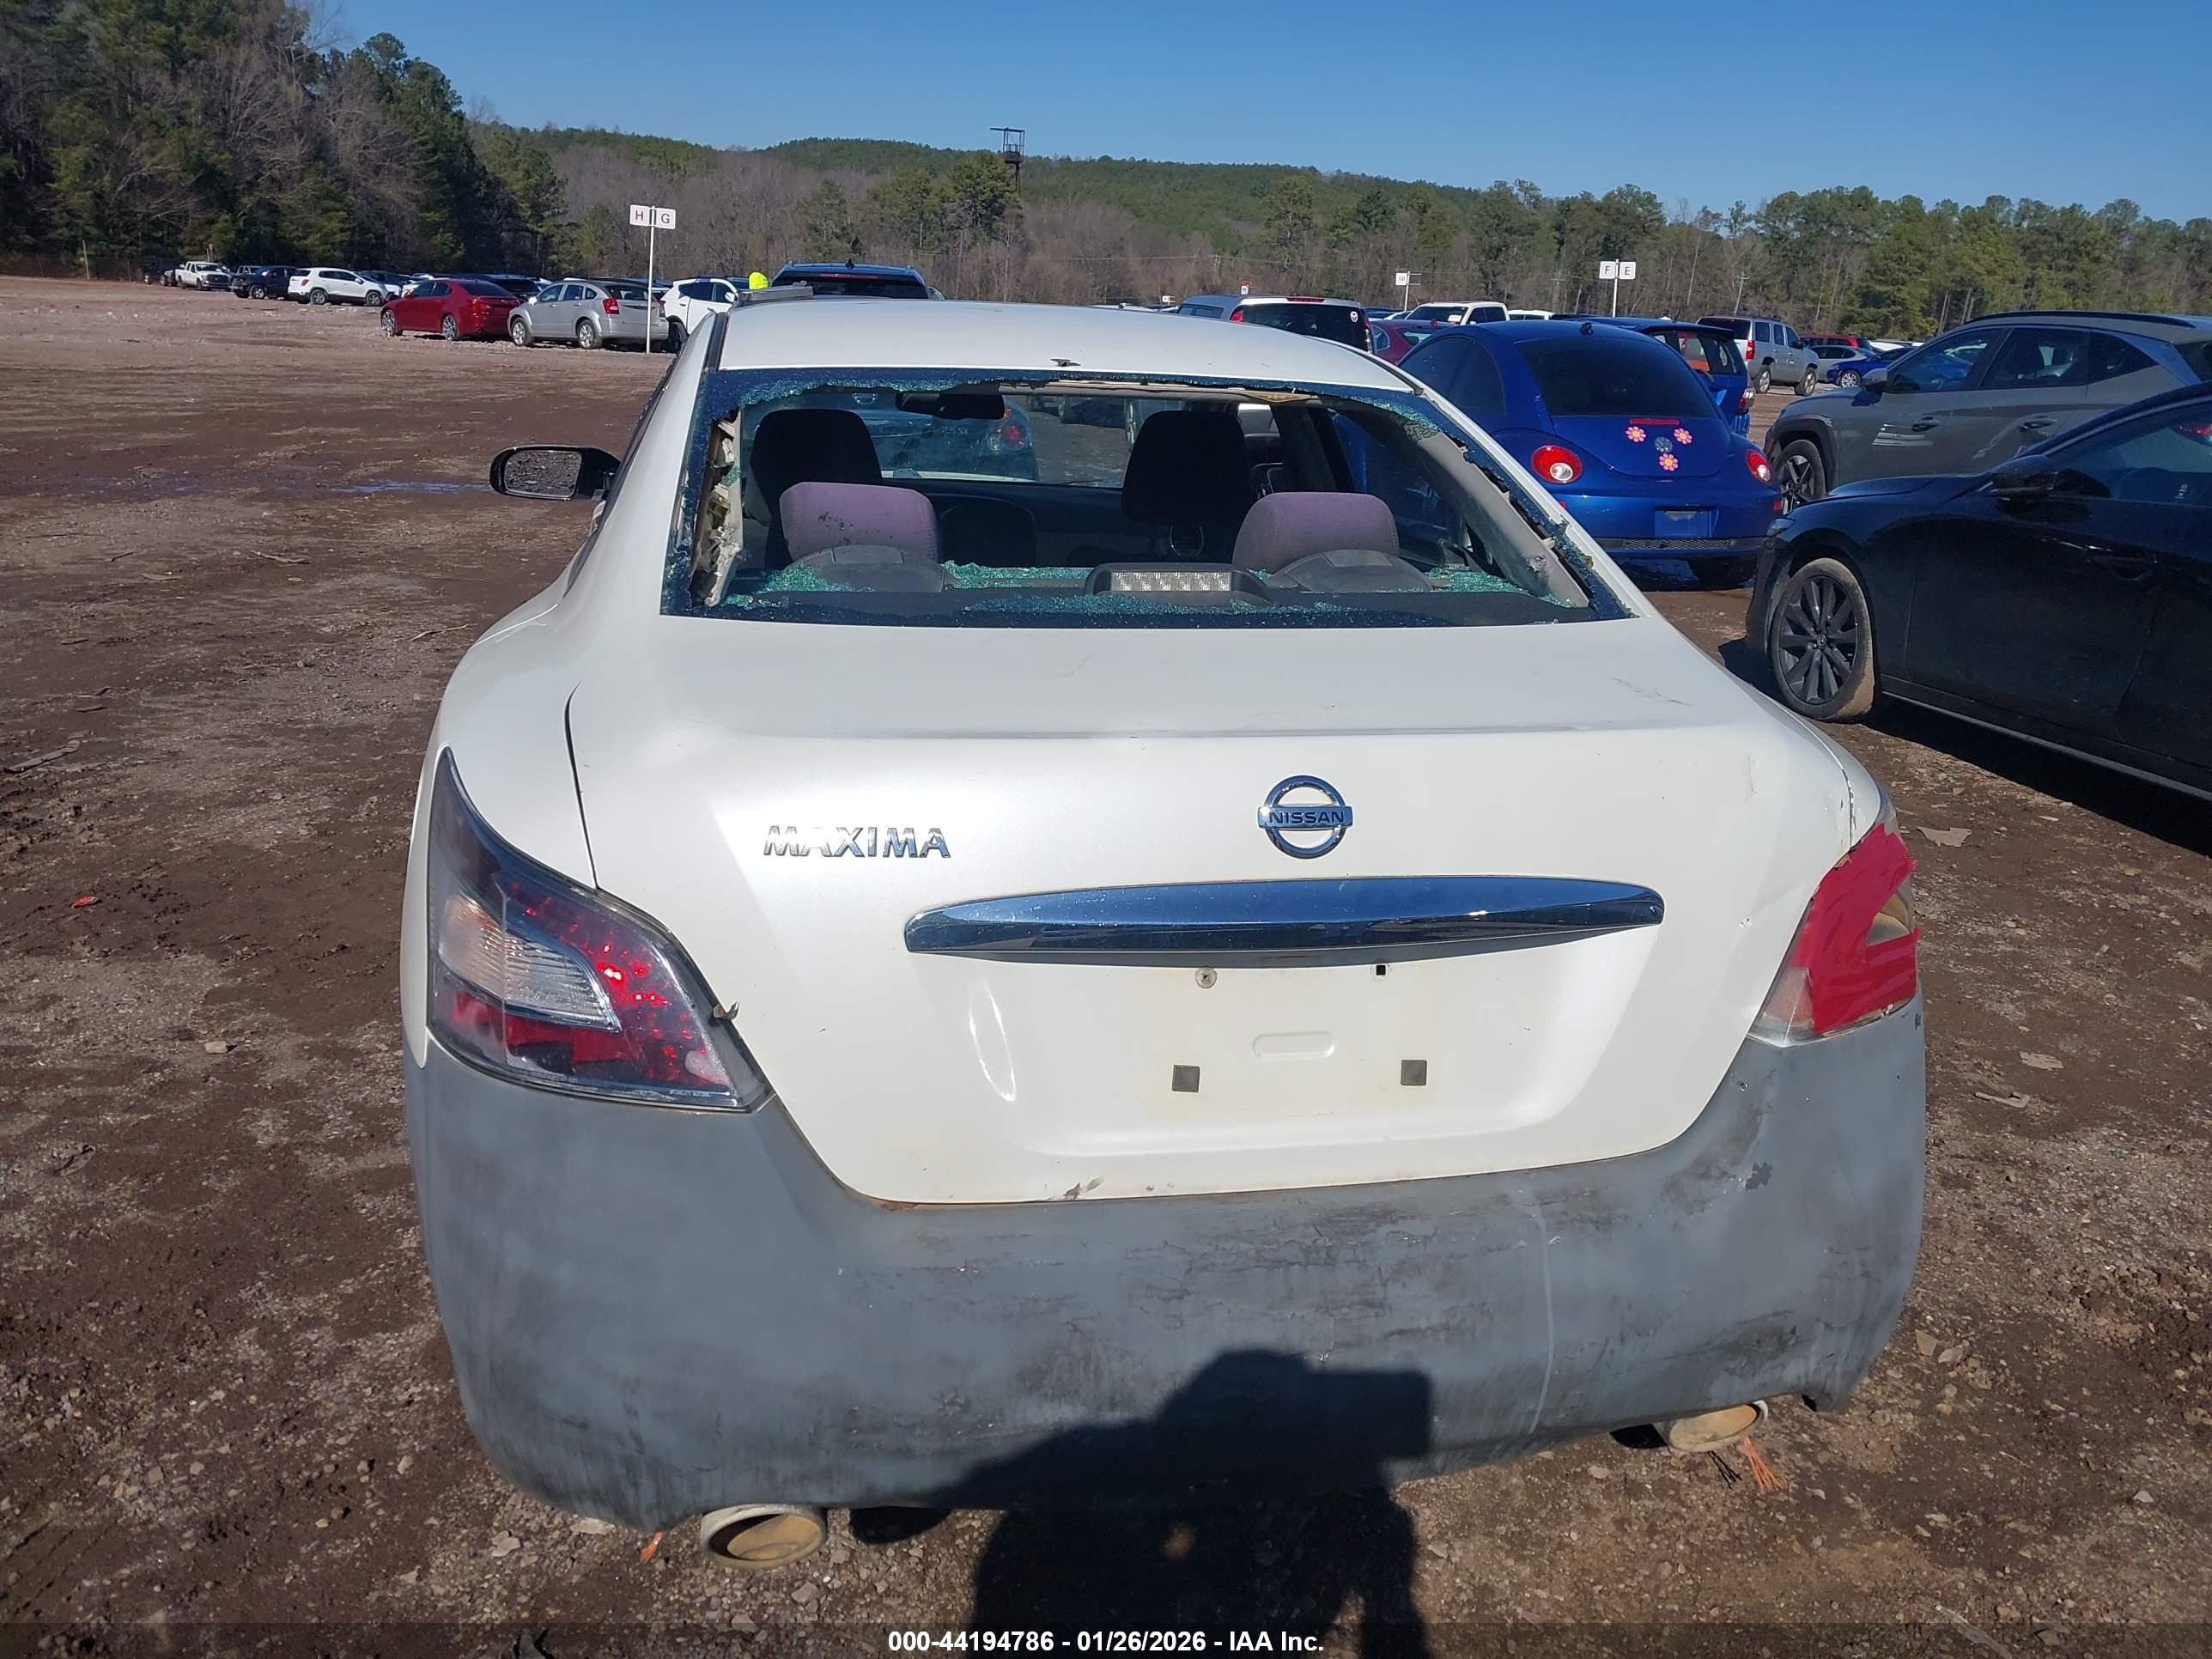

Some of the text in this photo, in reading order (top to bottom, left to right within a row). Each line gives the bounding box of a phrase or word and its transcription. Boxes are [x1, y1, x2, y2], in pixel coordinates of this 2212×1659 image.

[635, 210, 644, 221] H
[660, 213, 670, 223] G
[1604, 265, 1611, 275] F
[1625, 266, 1631, 275] E
[1269, 811, 1344, 824] NISSAN
[763, 825, 951, 858] MAXIMA
